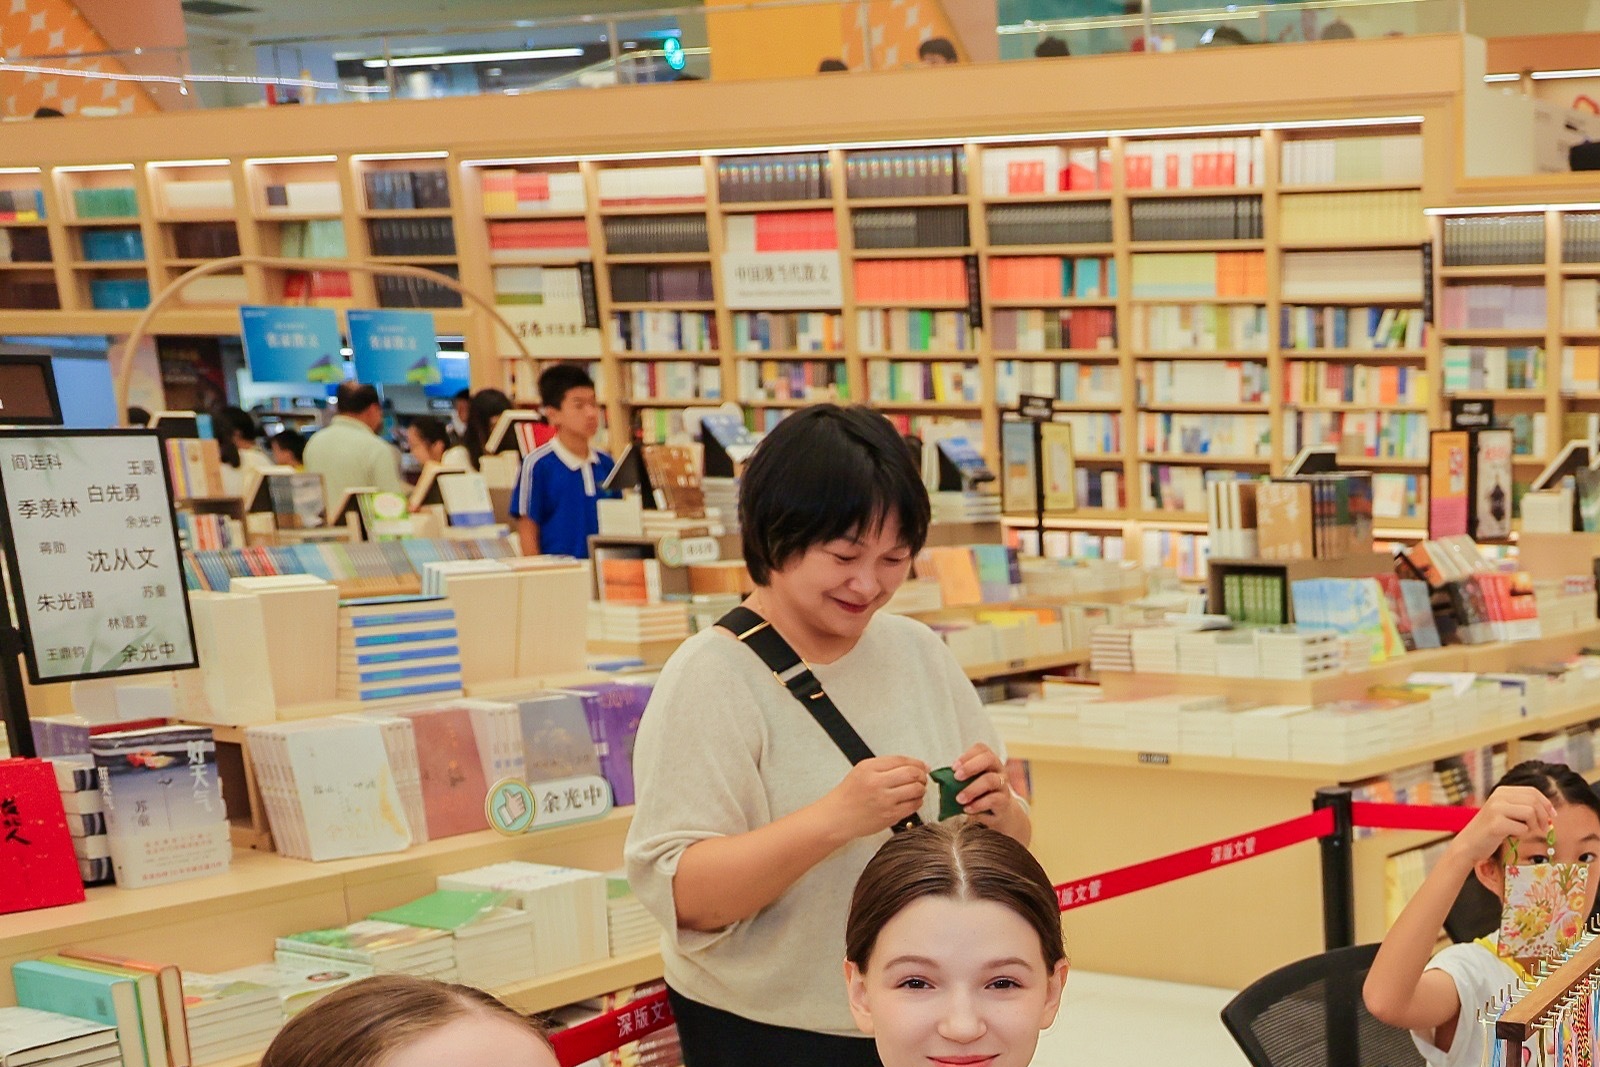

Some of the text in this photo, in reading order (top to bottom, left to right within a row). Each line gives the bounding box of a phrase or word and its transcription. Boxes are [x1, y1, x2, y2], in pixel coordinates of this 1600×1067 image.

[127, 459, 157, 476] 王蒙
[87, 483, 141, 503] 白先勇
[17, 497, 82, 520] 季羡林
[124, 514, 163, 529] 余光中
[87, 547, 159, 573] 沈从文
[37, 590, 96, 613] 朱光潜
[107, 614, 149, 631] 林语堂
[121, 642, 176, 664] 余光中
[186, 740, 213, 813] 好天气
[542, 783, 602, 815] 余光中
[616, 1001, 675, 1038] 深版文
